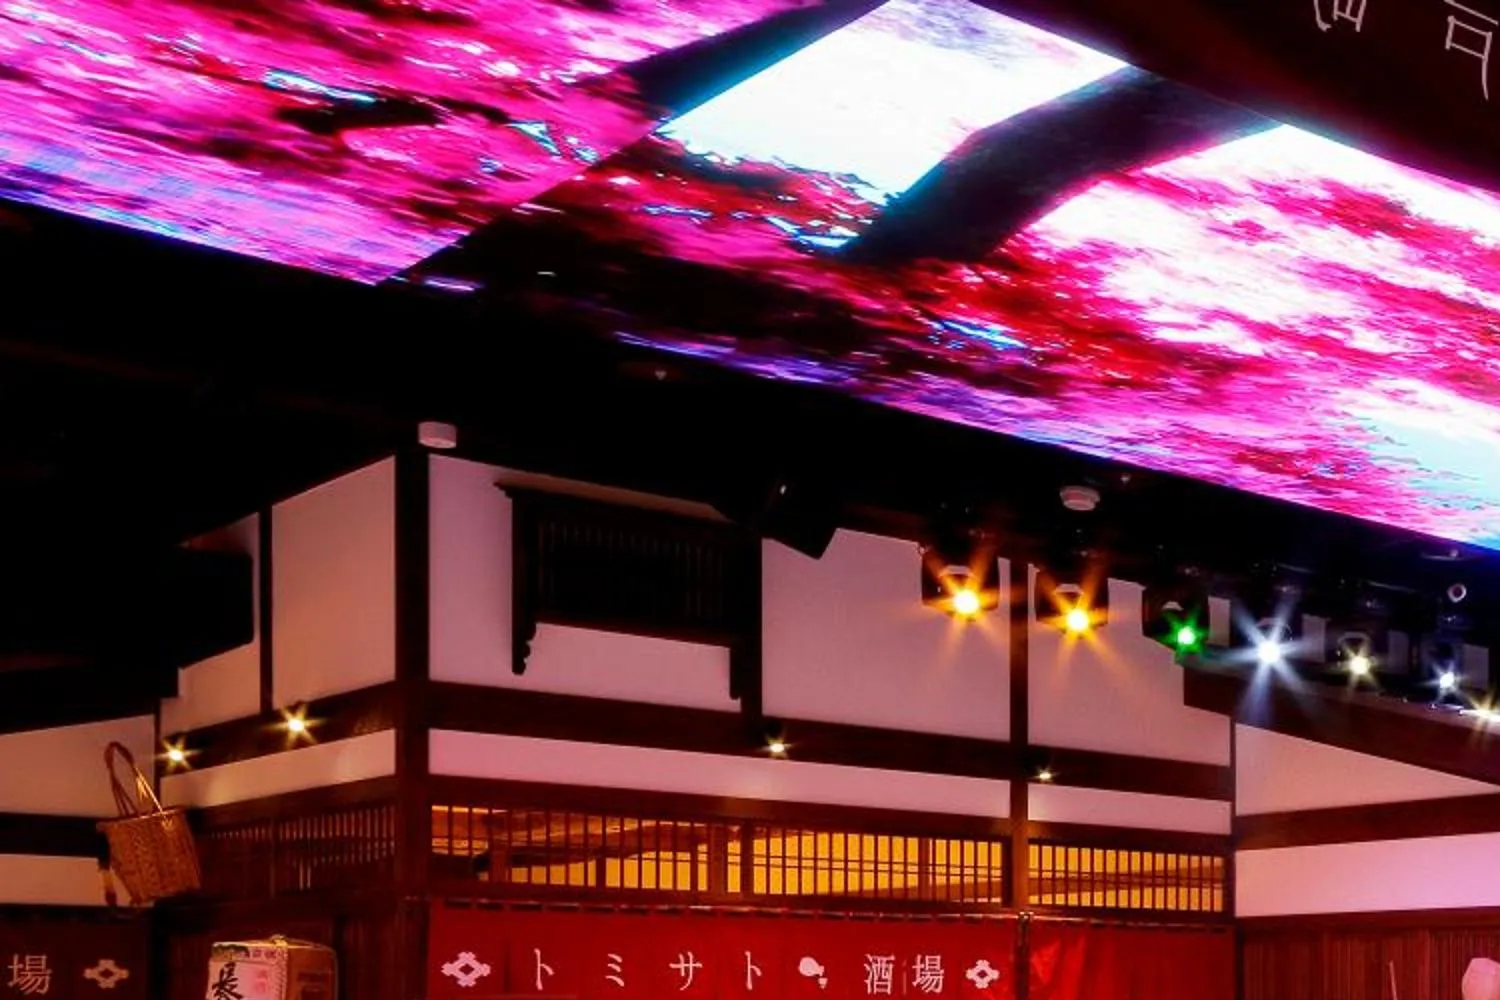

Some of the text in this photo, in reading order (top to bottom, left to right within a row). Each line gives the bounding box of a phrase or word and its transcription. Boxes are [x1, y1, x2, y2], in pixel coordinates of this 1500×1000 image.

[8, 954, 53, 996] 場
[534, 948, 946, 996] トミサト 酒場
